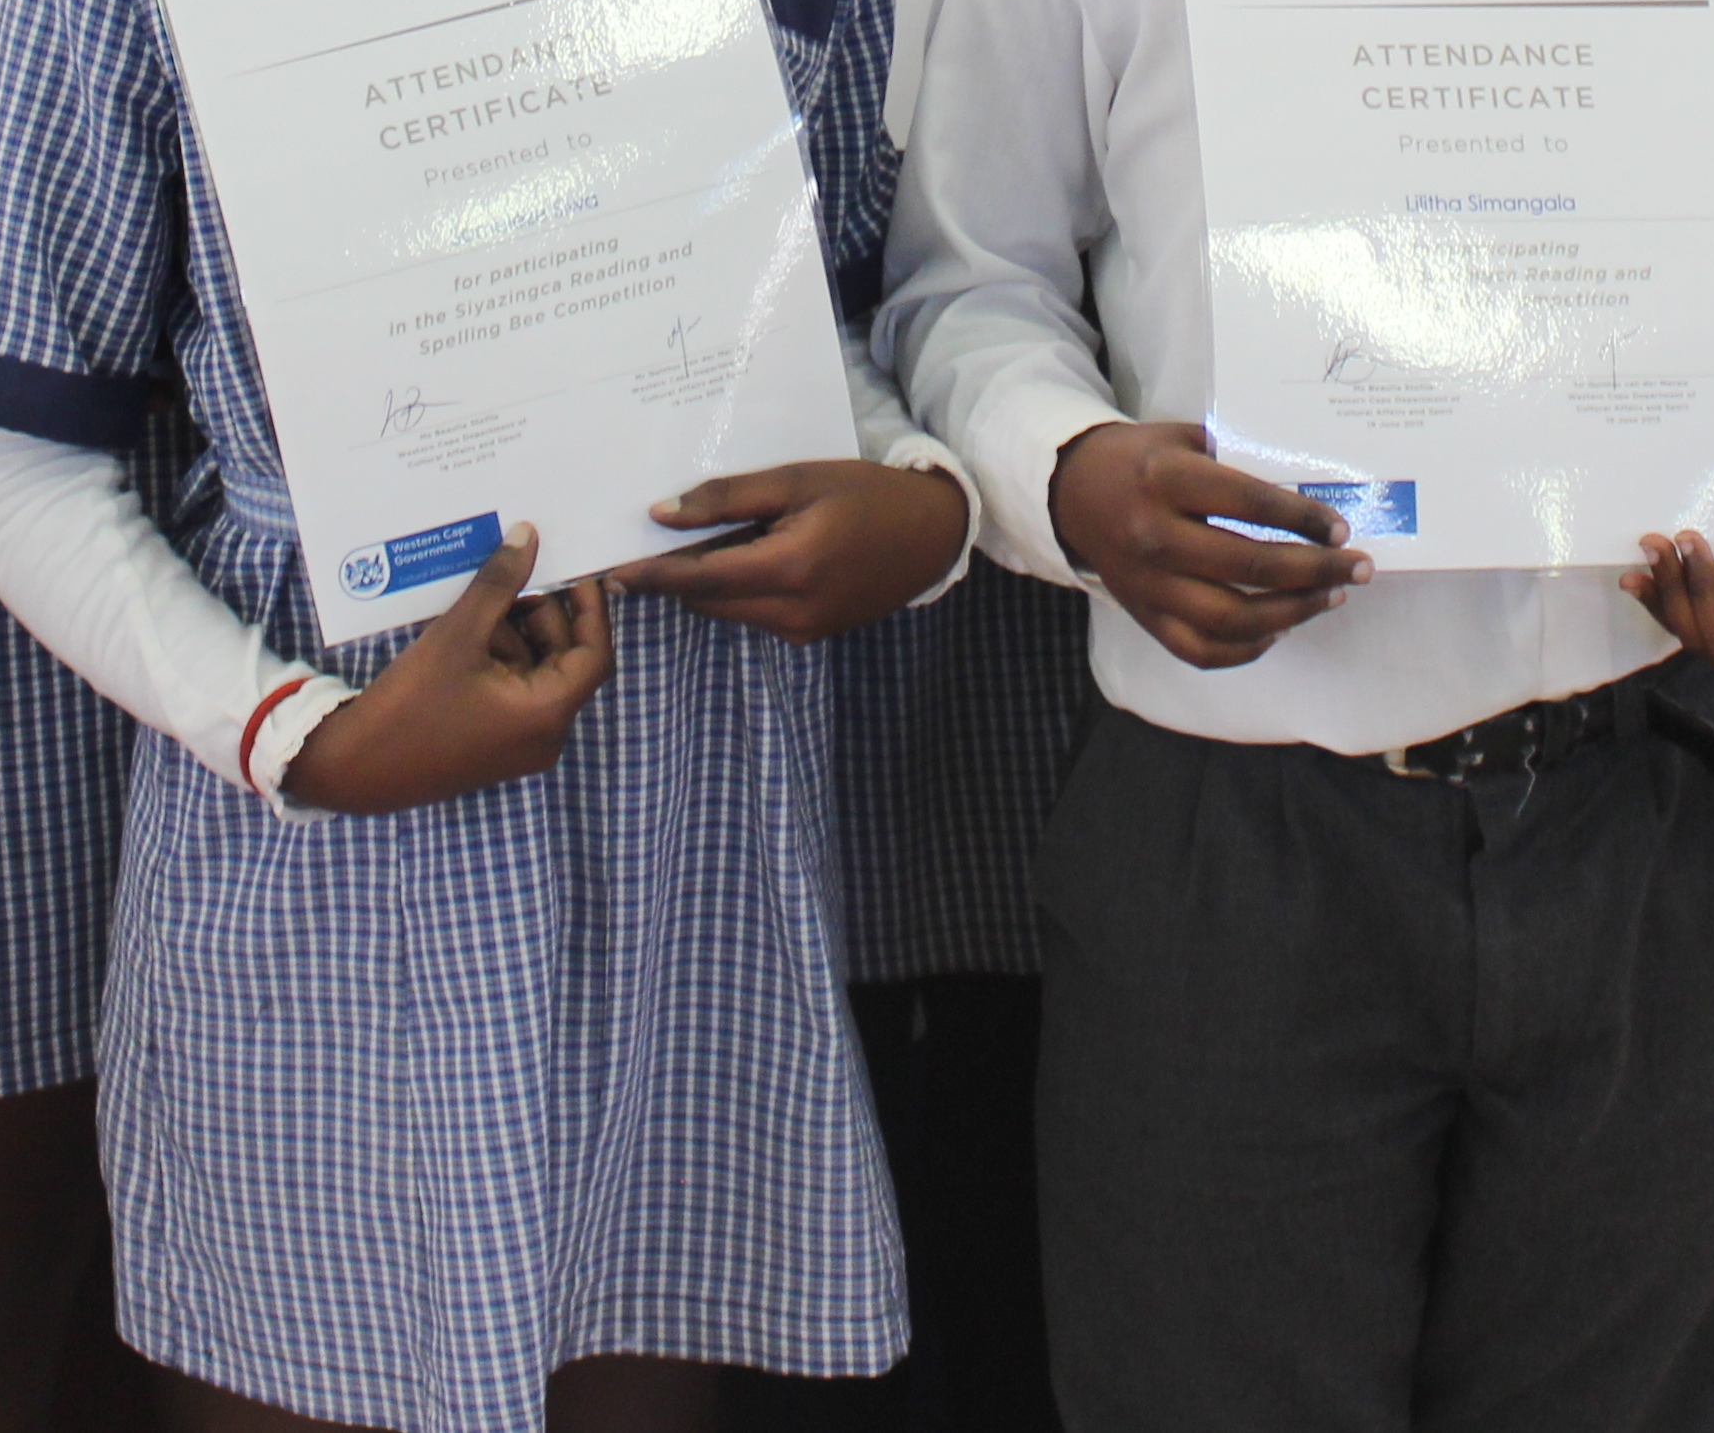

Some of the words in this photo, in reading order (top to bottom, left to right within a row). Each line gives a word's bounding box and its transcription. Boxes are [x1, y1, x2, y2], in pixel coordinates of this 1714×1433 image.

[1352, 43, 1595, 68] ATTENDANCE
[378, 70, 613, 151] CERTIFICATE
[1361, 85, 1595, 110] CERTIFICATE
[1398, 133, 1526, 154] Presented
[1543, 134, 1569, 153] to
[423, 138, 550, 189] Presented
[565, 132, 593, 151] to
[1405, 193, 1463, 214] Lilitha
[1468, 193, 1577, 216] Simangala
[453, 274, 482, 292] for
[489, 236, 620, 285] participating
[1525, 264, 1608, 284] Reading
[1614, 264, 1653, 282] and
[388, 320, 407, 337] in
[414, 311, 447, 331] the
[570, 255, 651, 289] Reading
[657, 241, 693, 265] and
[418, 321, 502, 356] Spelling
[509, 310, 546, 331] Bee
[553, 273, 677, 319] Competition
[392, 535, 441, 554] Western
[442, 523, 474, 542] Cape
[393, 537, 466, 567] Government
